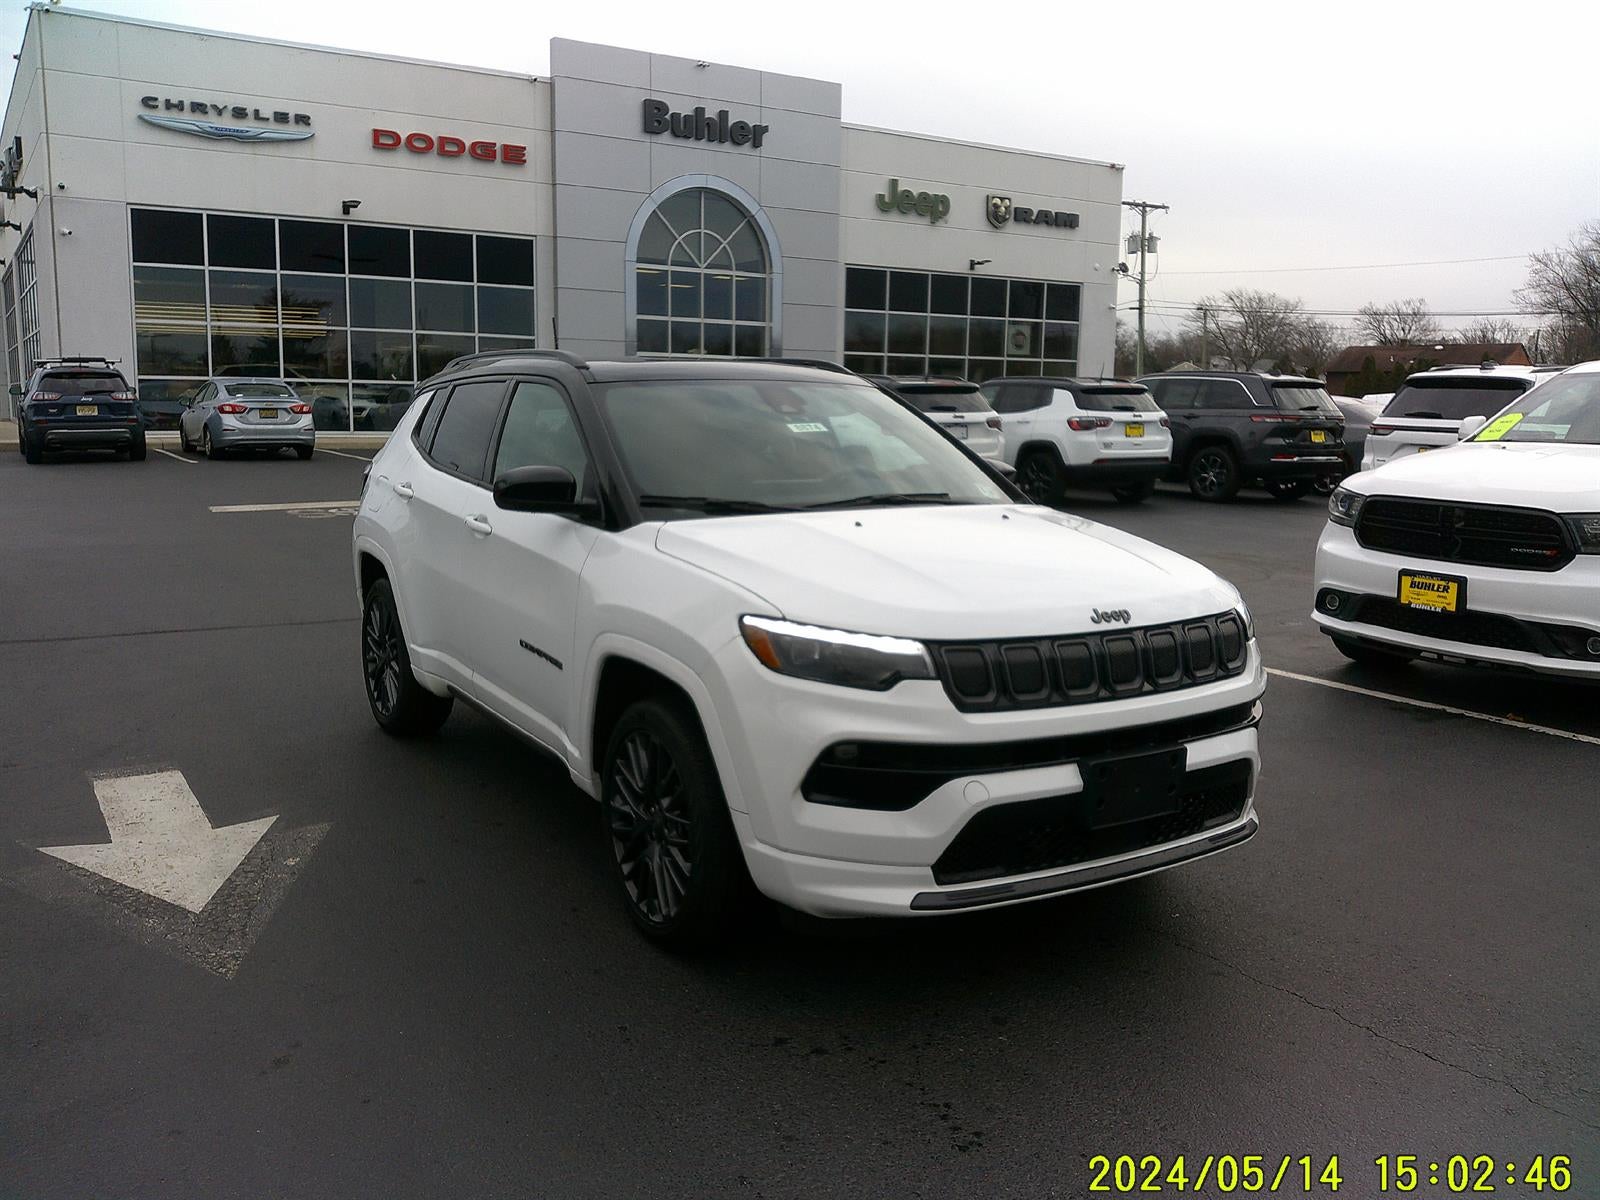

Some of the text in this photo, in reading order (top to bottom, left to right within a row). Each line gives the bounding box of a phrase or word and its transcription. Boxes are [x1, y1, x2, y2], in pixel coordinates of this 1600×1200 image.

[141, 96, 312, 126] CHRYSLER
[643, 98, 769, 148] Buhler
[372, 128, 527, 165] DODGE
[875, 178, 951, 224] Jeep
[1013, 206, 1080, 229] RAM
[1409, 580, 1450, 593] BUHLER
[1090, 607, 1131, 624] Jeep
